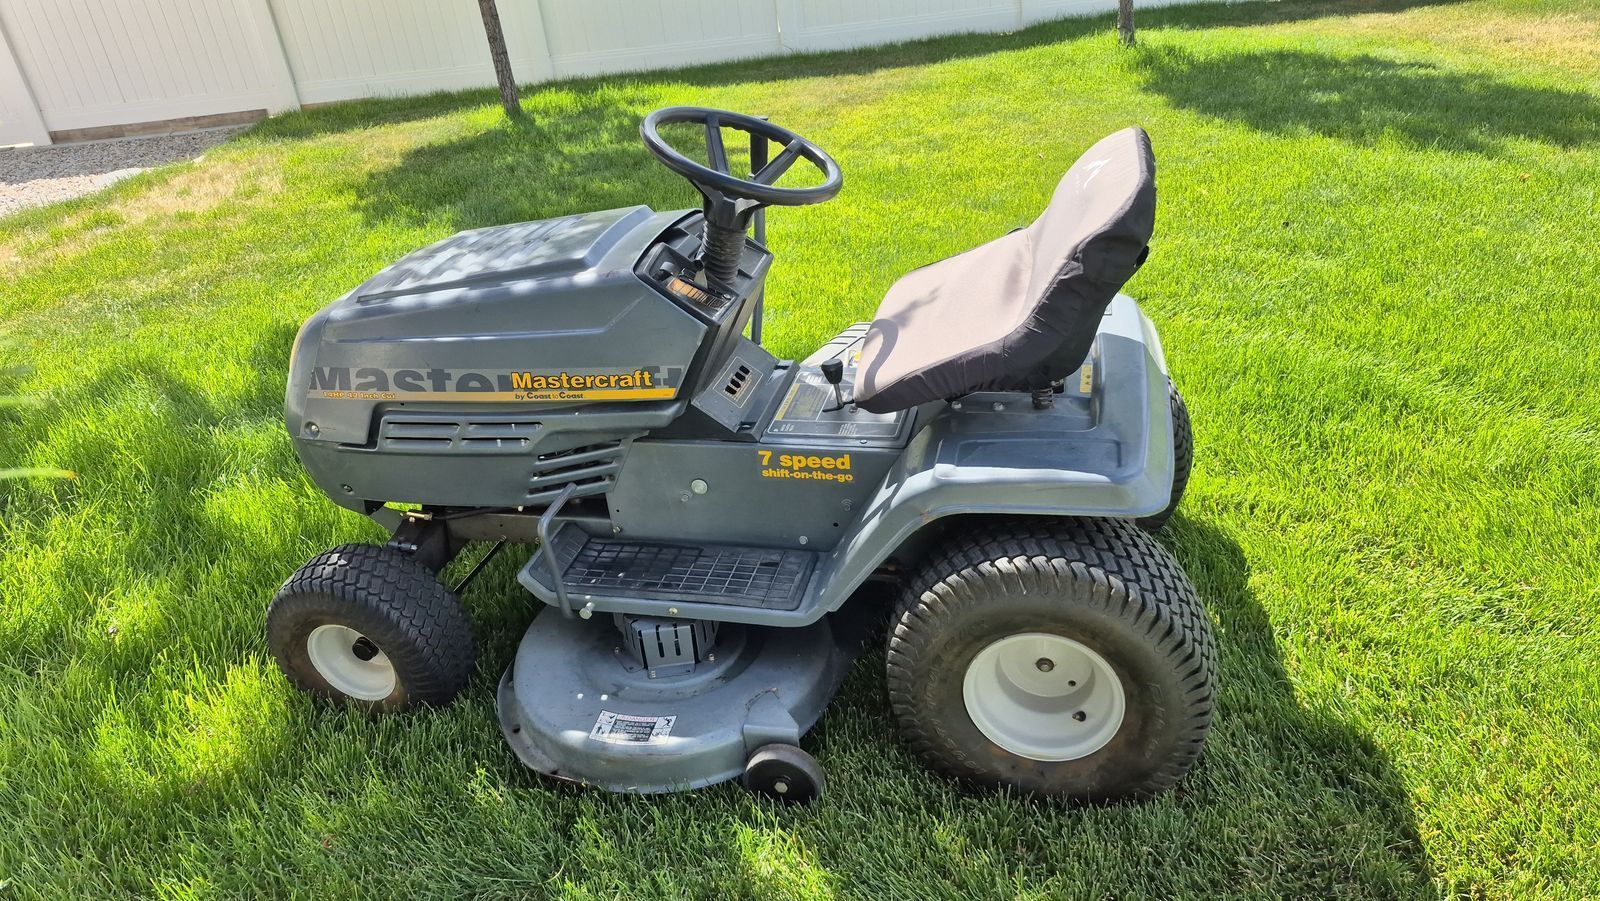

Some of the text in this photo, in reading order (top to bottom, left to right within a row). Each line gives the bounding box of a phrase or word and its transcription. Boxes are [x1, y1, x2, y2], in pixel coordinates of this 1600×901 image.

[511, 369, 653, 389] Mastercraft
[526, 391, 551, 399] Coast
[559, 391, 584, 399] Coast
[758, 450, 851, 470] 7 speed
[762, 468, 853, 483] shift-on-the-go
